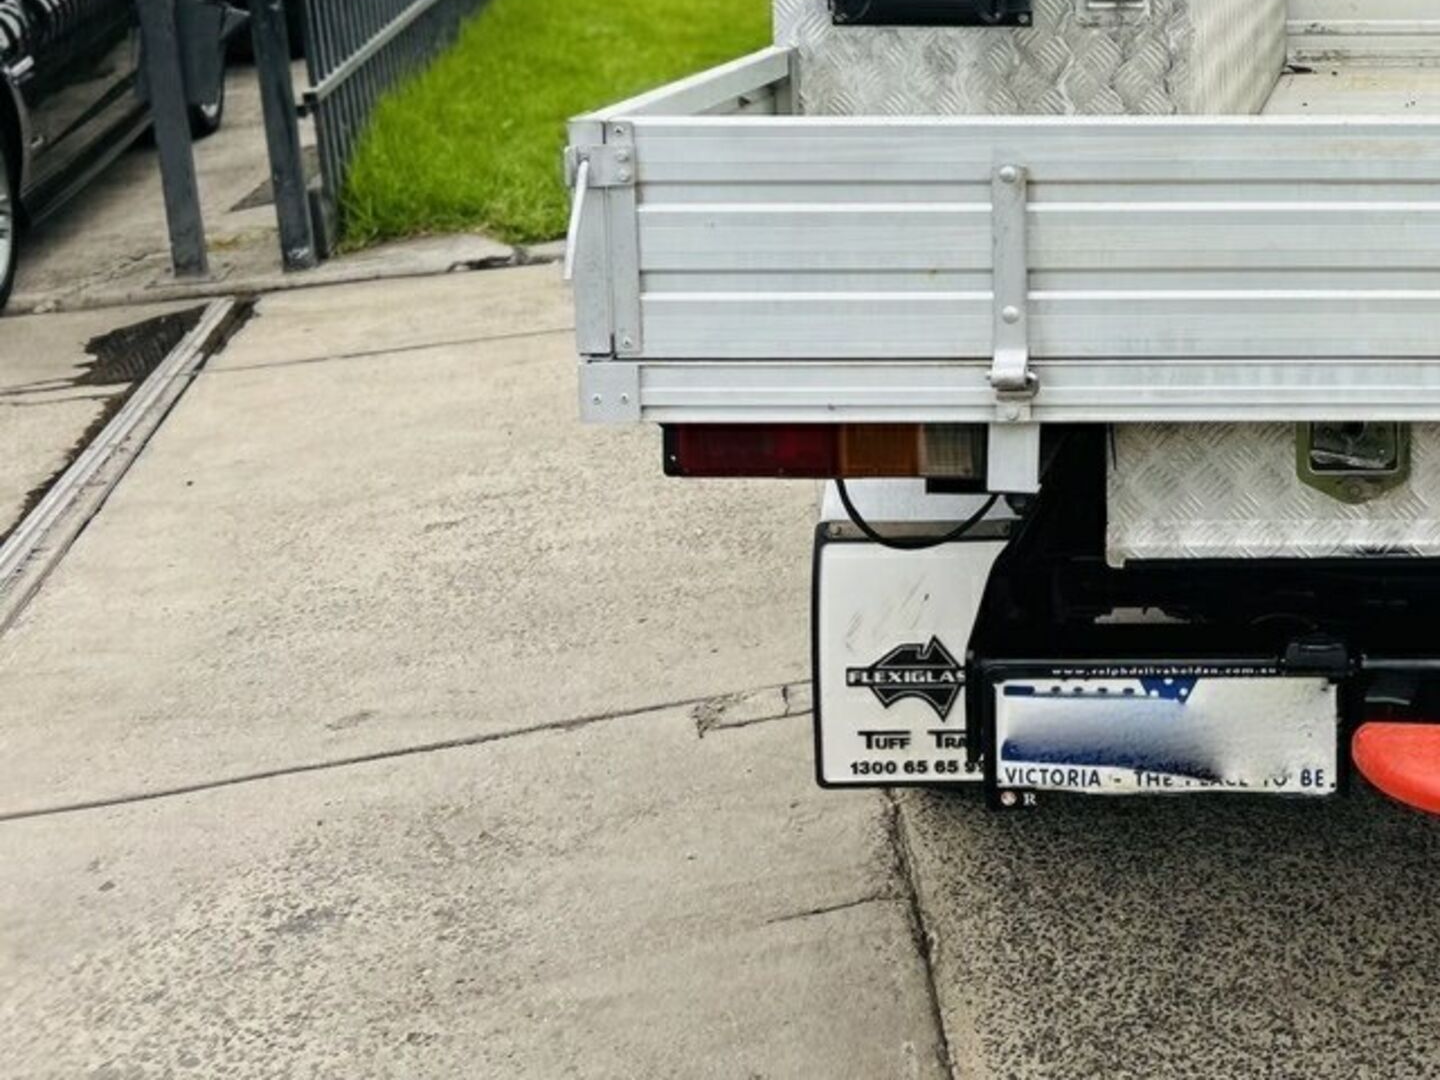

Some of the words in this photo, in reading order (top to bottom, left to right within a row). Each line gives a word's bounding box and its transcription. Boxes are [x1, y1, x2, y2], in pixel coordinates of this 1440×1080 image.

[848, 671, 966, 683] FLEXIGLAS
[857, 730, 911, 750] TUFF
[927, 730, 967, 749] TRA
[850, 761, 897, 775] 1300
[903, 760, 928, 775] 65
[934, 760, 959, 774] 65
[1005, 767, 1101, 787] VICTORIA
